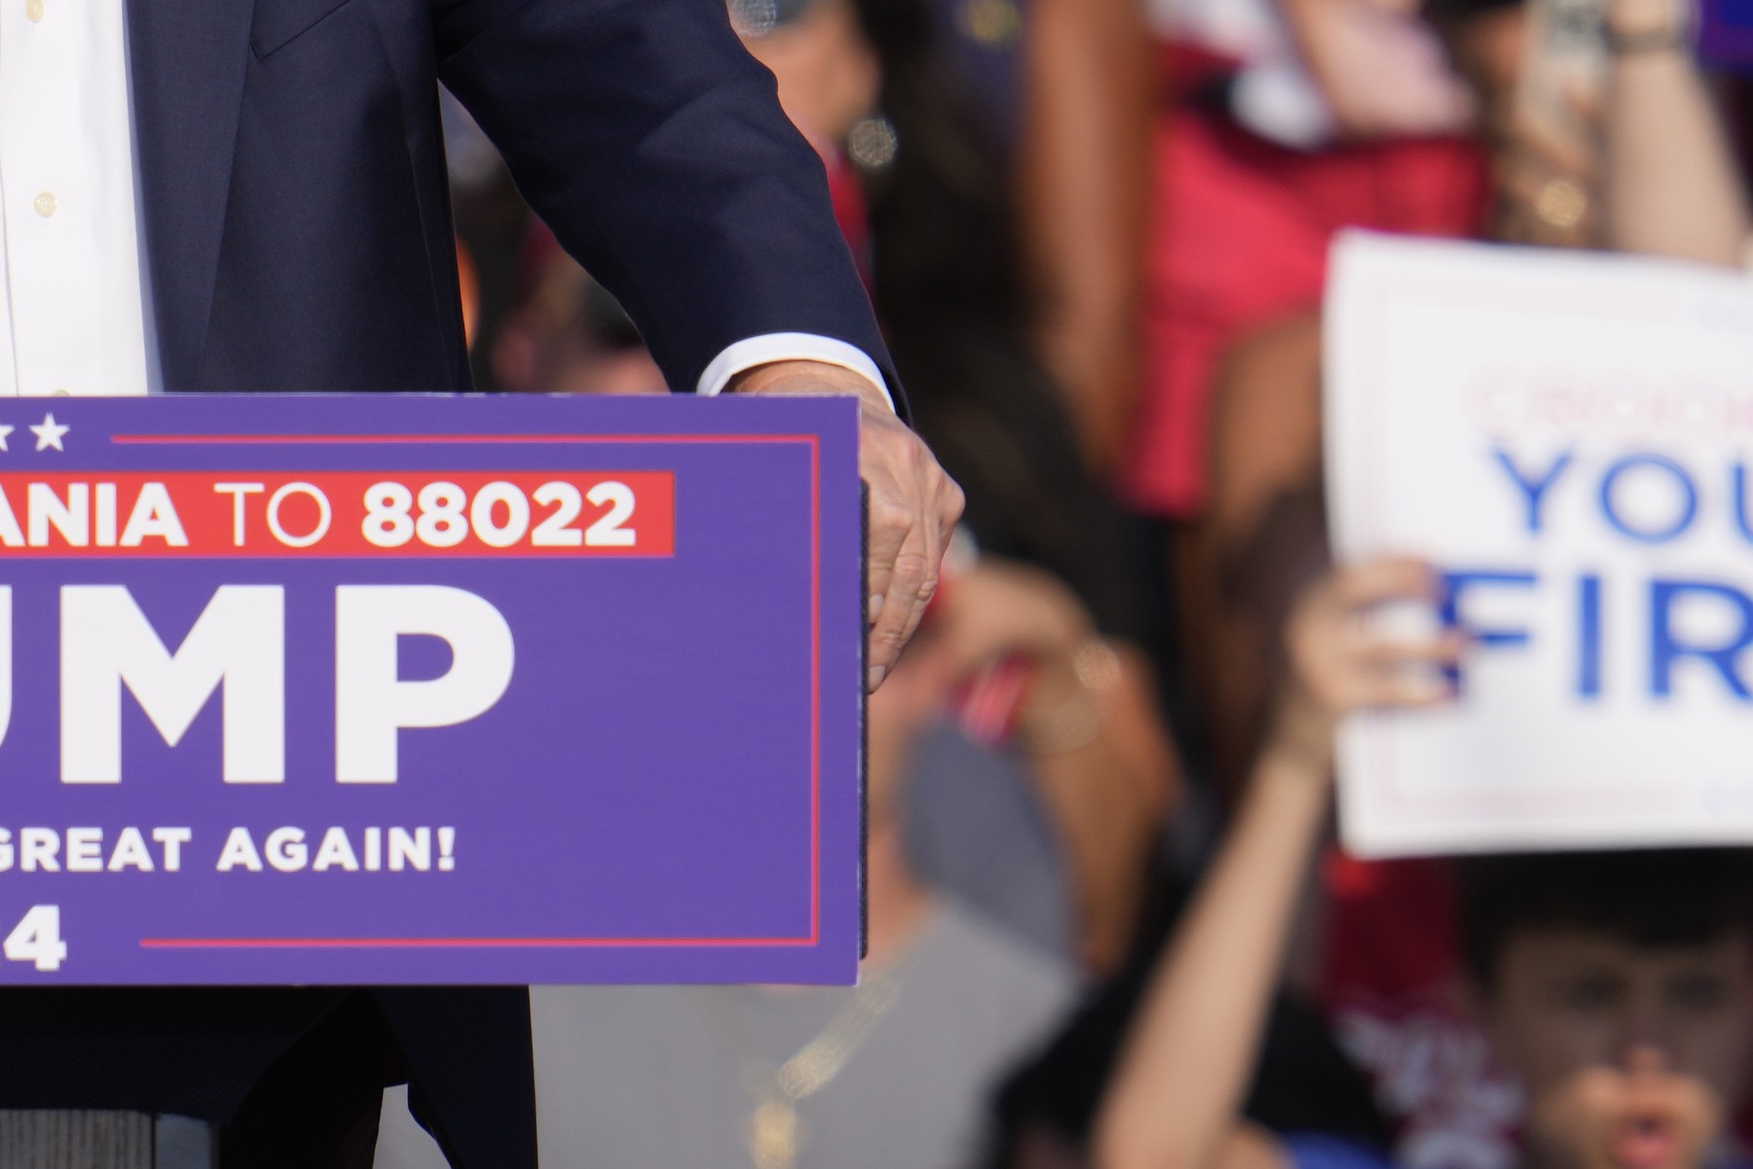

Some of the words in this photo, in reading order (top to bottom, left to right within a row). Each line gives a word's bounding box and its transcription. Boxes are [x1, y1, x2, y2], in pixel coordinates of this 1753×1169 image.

[214, 482, 332, 548] TO
[361, 481, 636, 548] 88022
[216, 826, 456, 872] AGAIN!
